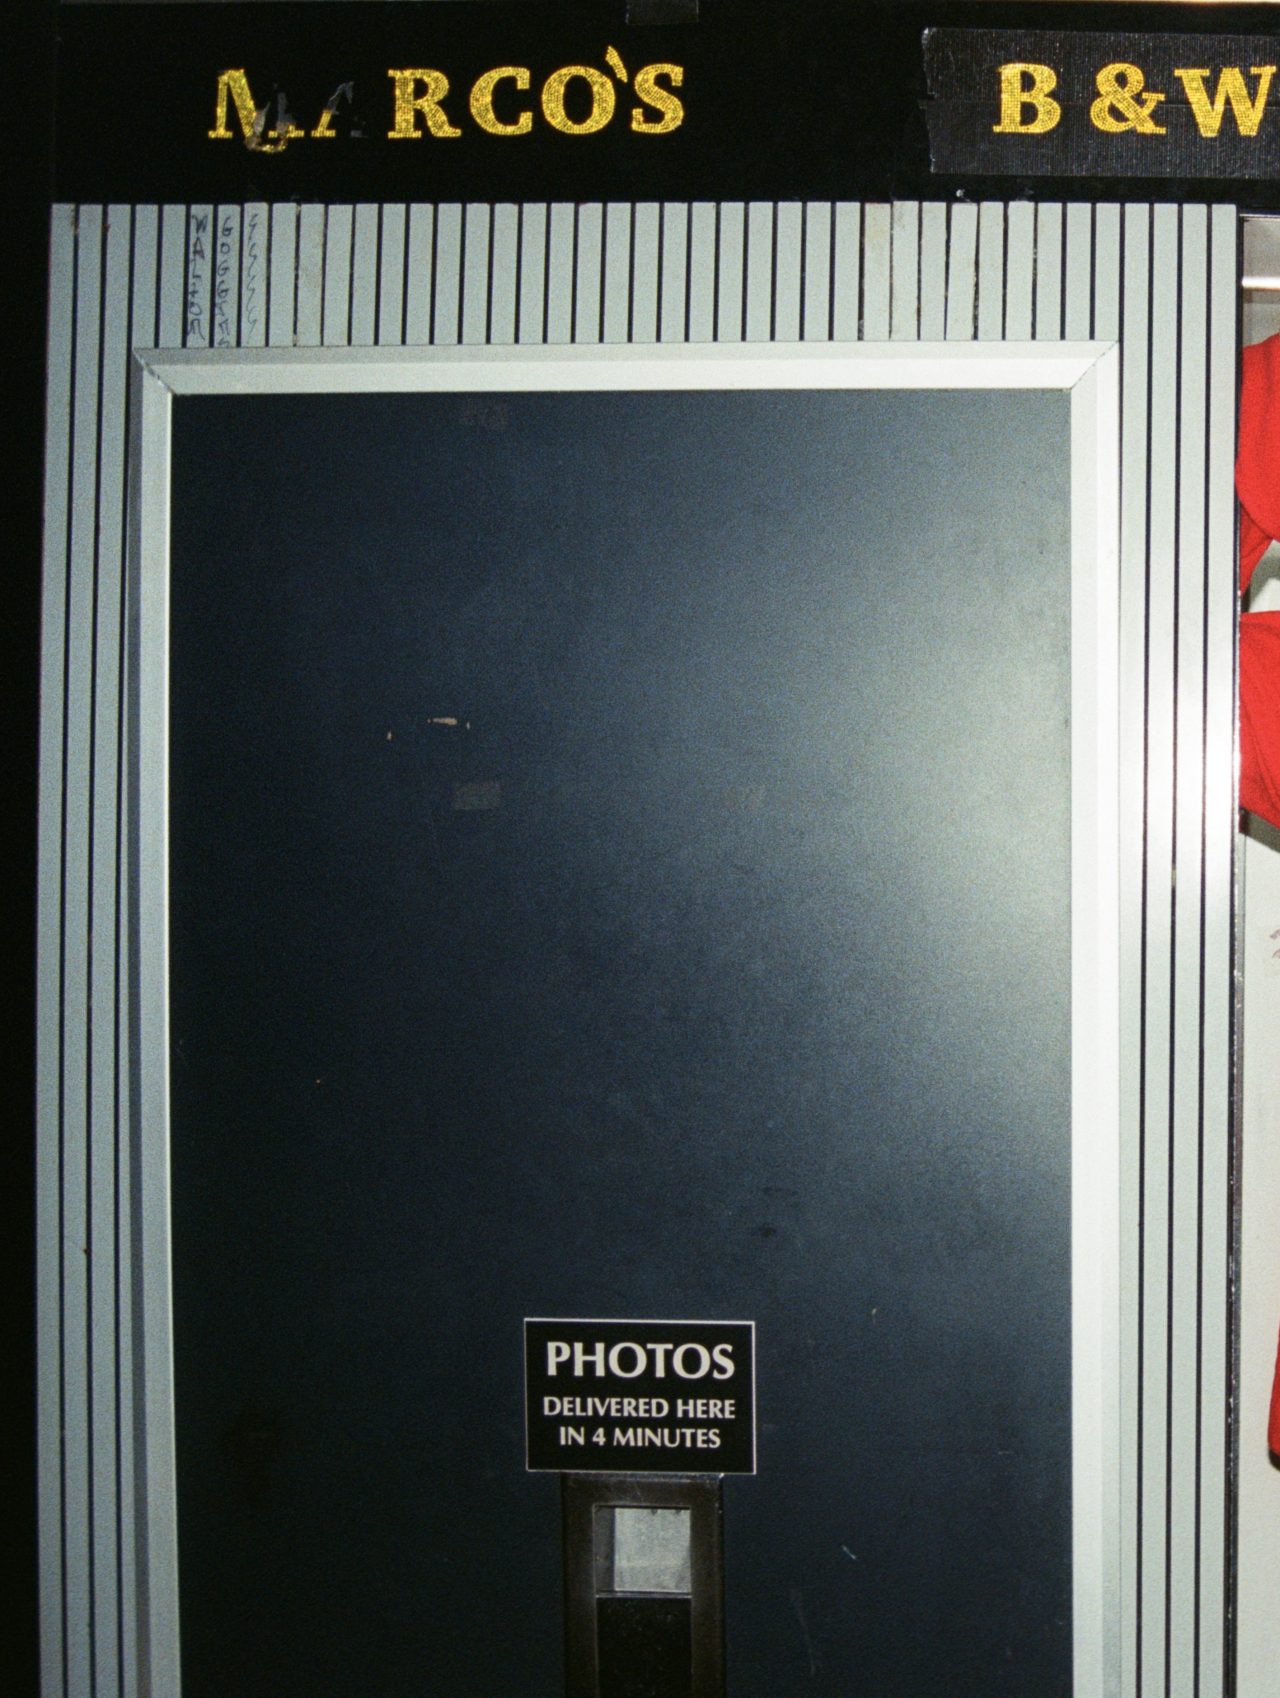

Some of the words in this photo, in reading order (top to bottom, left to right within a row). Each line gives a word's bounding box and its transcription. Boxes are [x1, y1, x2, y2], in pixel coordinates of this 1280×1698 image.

[547, 1341, 734, 1379] PHOTOS
[543, 1396, 668, 1417] DELIVERED
[676, 1398, 735, 1418] HERE
[559, 1426, 584, 1445] IN
[592, 1427, 605, 1445] 4
[613, 1427, 720, 1448] MINUTES
